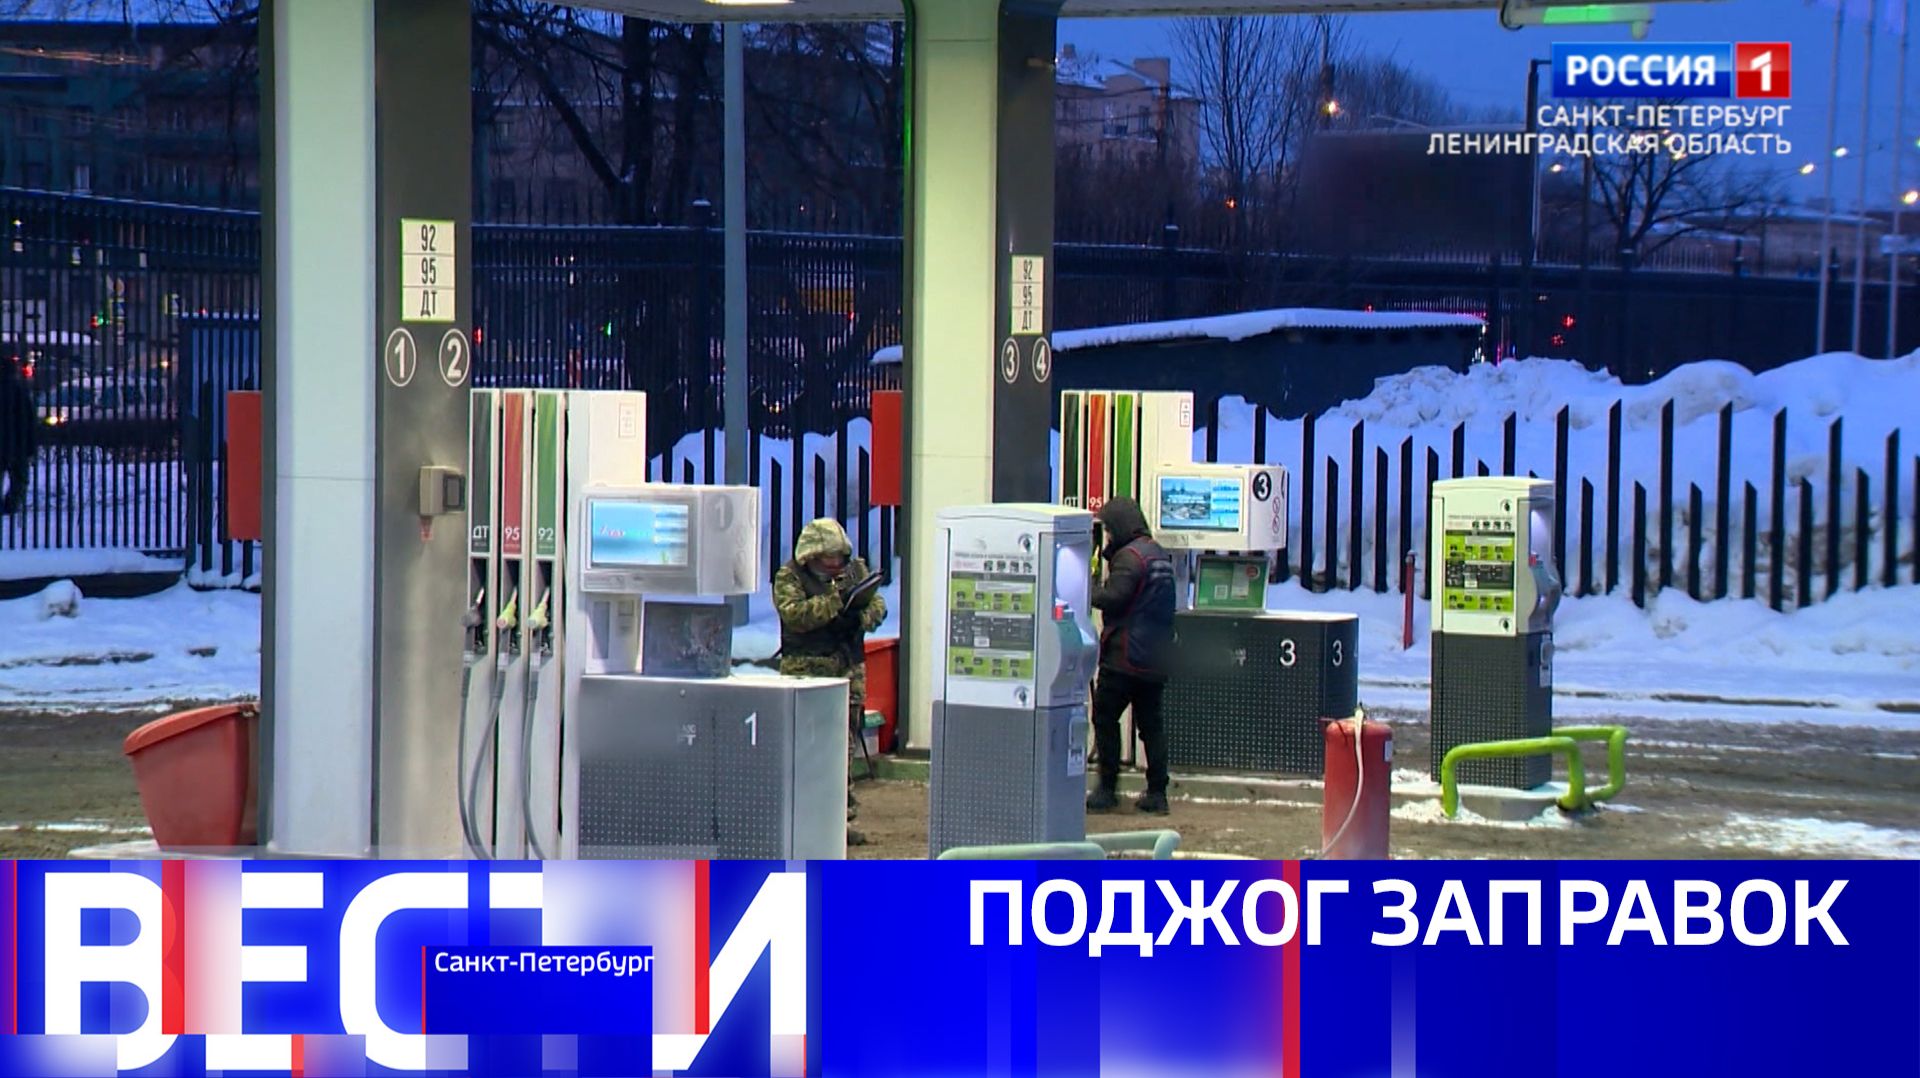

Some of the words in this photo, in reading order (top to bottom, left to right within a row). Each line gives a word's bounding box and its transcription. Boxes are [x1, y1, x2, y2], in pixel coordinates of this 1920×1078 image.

[421, 224, 436, 252] 92
[421, 257, 437, 285] 95
[1023, 259, 1033, 281] 92
[420, 290, 438, 318] ДТ
[1022, 285, 1033, 306] 95
[1021, 310, 1033, 331] ДТ
[394, 336, 406, 379] 1
[446, 337, 463, 379] 2
[1006, 345, 1015, 377] 3
[1036, 344, 1046, 376] 4
[1257, 475, 1268, 498] 3
[714, 499, 726, 529] 1
[1089, 496, 1103, 508] 95
[472, 525, 489, 539] ДТ
[504, 526, 520, 541] 95
[538, 527, 554, 541] 92
[1279, 638, 1297, 667] 3
[1332, 639, 1343, 667] 3
[744, 711, 757, 746] 1
